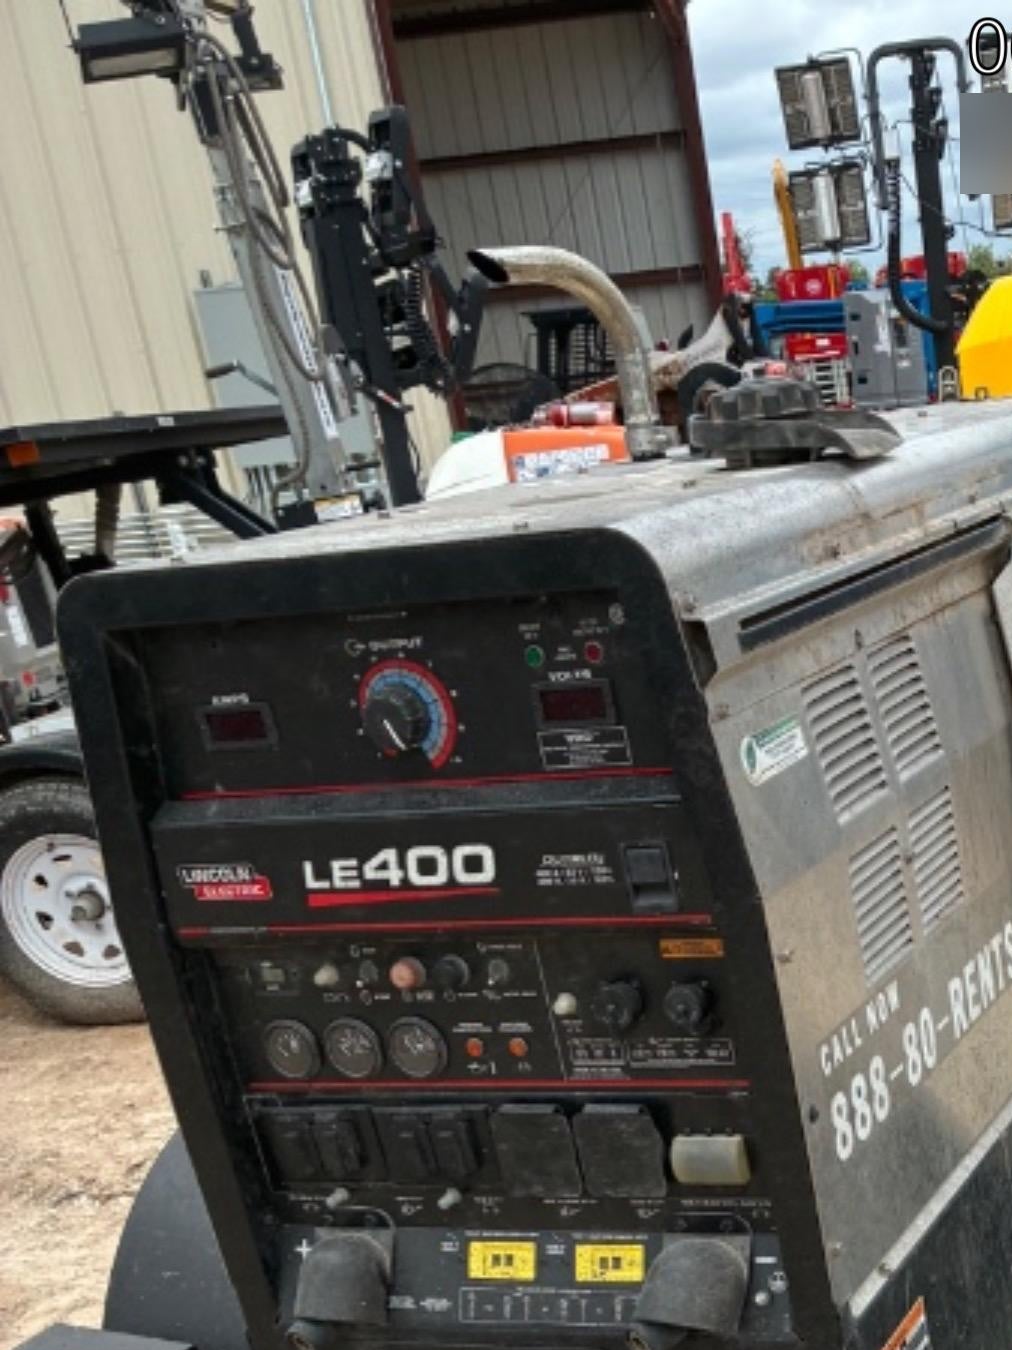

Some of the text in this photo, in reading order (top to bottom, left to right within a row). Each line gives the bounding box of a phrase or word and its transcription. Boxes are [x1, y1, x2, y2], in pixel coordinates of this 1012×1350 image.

[182, 865, 251, 883] LINCOLN
[303, 844, 496, 889] LE400
[820, 979, 900, 1077] CALL NOW
